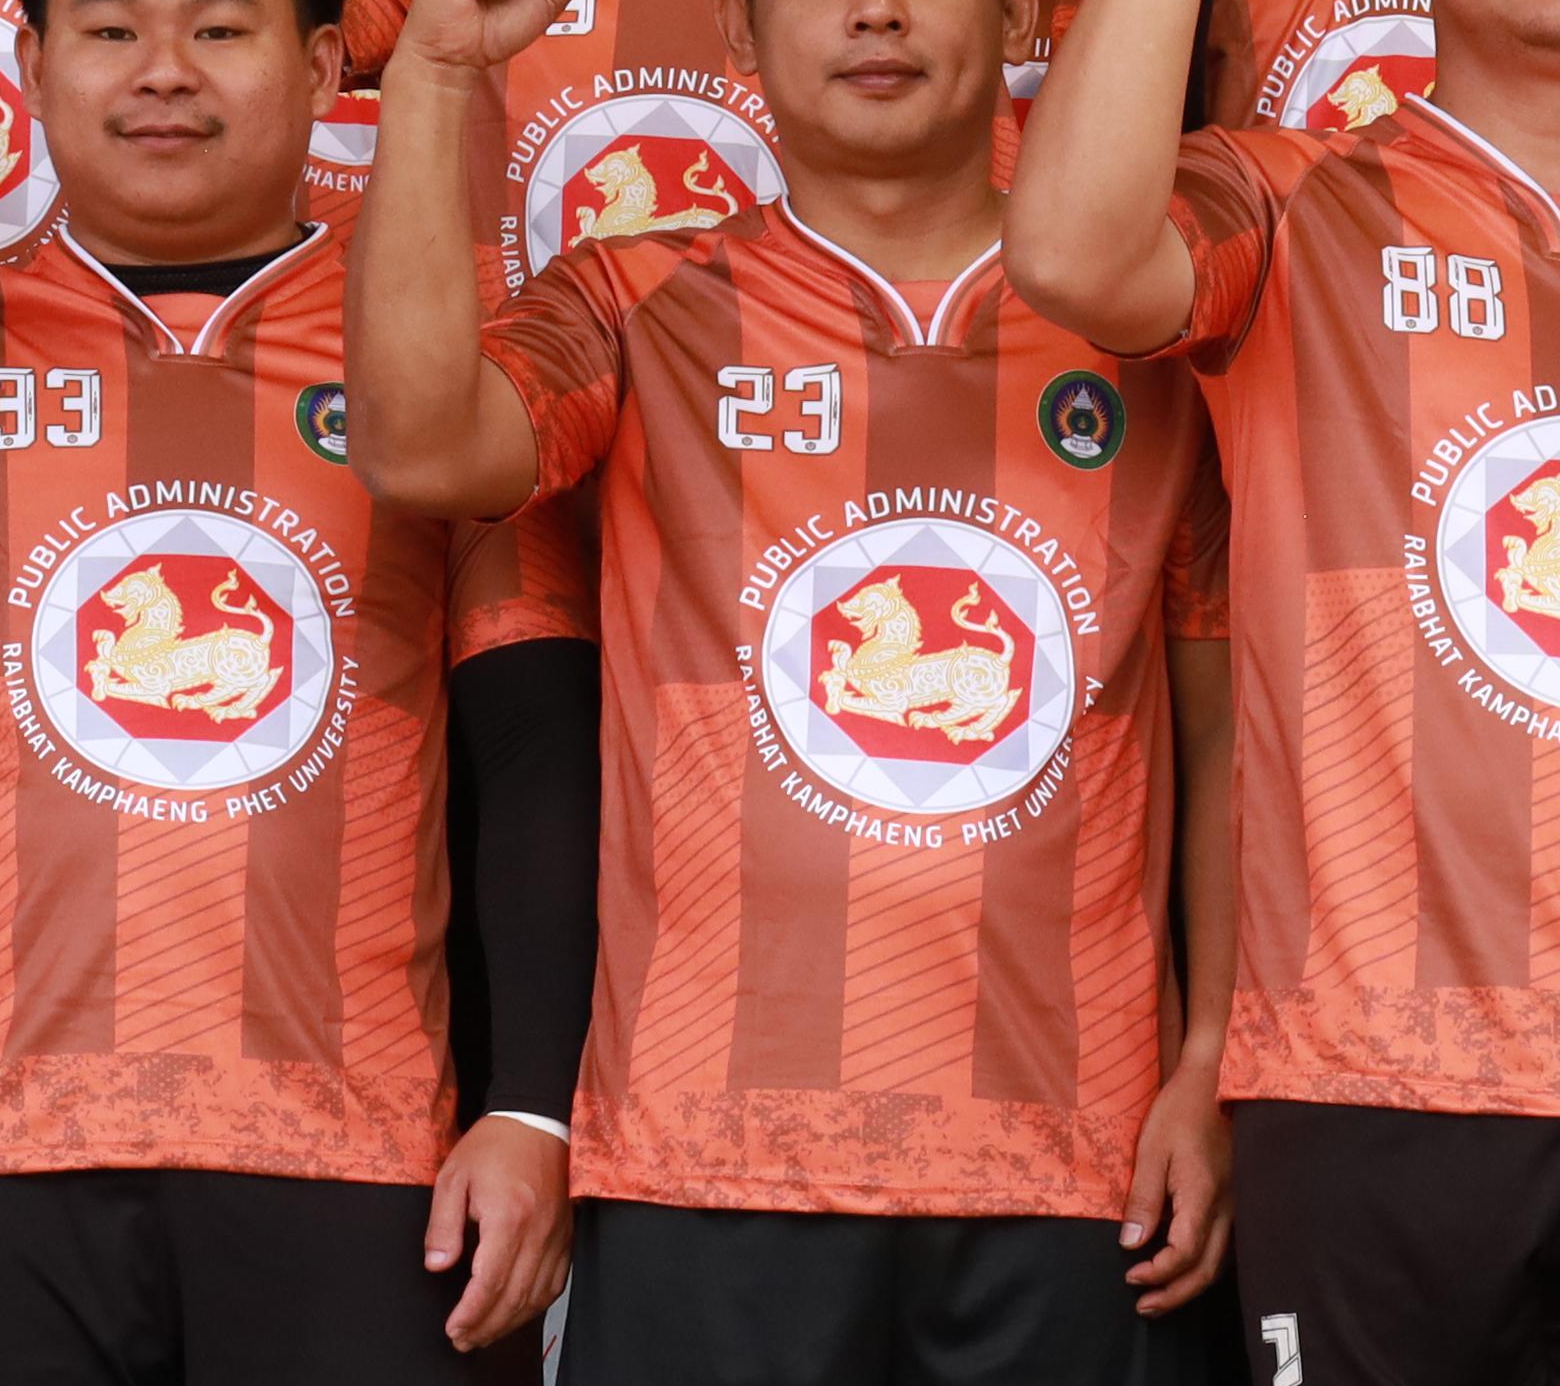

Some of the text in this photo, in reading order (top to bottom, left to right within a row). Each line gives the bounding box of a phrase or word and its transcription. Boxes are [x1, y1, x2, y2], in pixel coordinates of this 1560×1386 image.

[1256, 15, 1327, 118] PUBLIC
[506, 66, 781, 183] PUBLIC ADMINISTRA
[1381, 244, 1506, 342] 88
[716, 362, 842, 455] 23
[1410, 402, 1504, 506] PUBLIC
[8, 480, 356, 618] PUBLIC ADMINISTRATION
[739, 486, 1100, 635] PUBLIC ADMINISTRATION
[51, 757, 208, 823] KAMPHAENG
[226, 783, 287, 818] PHET
[289, 656, 360, 794] UNIVERSITY
[779, 770, 942, 849] KAMPHAENG
[962, 809, 1022, 846] PHET
